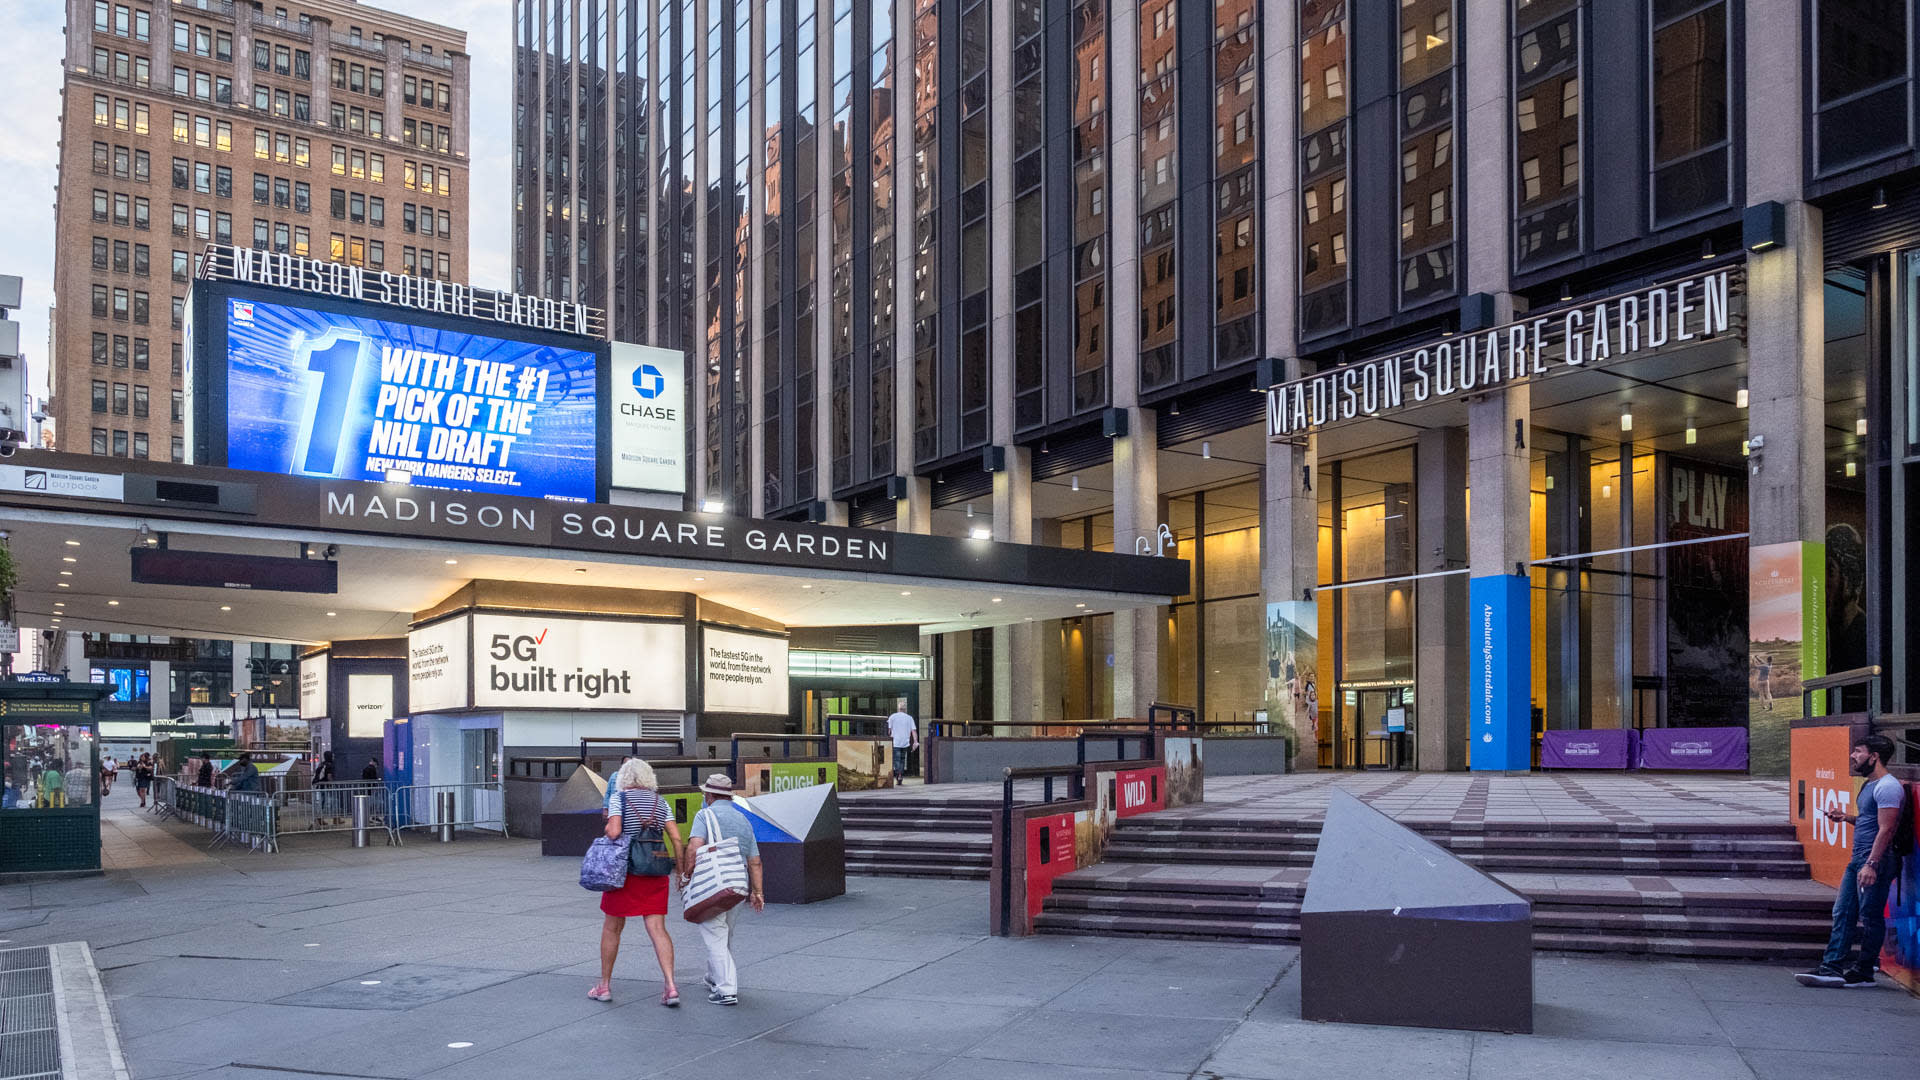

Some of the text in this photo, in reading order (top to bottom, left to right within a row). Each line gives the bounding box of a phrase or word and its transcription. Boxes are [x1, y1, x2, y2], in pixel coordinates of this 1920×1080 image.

[233, 246, 587, 335] MADISON SQUARE GARDEN
[381, 346, 550, 402] WITH THE #1
[1268, 271, 1728, 436] MADISON SQUARE GARDEN
[294, 329, 370, 478] 1
[375, 384, 536, 435] PICK OF THE
[620, 402, 676, 421] CHASE
[368, 419, 516, 467] NHL DRAFT
[365, 456, 395, 473] NEW
[395, 459, 425, 477] YORK
[425, 462, 476, 482] RANGERS
[475, 467, 522, 487] SELECT...
[1672, 467, 1728, 529] PLAY
[327, 491, 886, 560] MADISON SQUARE GARDEN
[490, 634, 537, 661] 5G
[710, 648, 763, 663] The fastest 5G in the
[710, 661, 771, 674] world, from the network
[1483, 603, 1494, 725] AbsolutelyScottsdale.com
[490, 665, 631, 698] built right
[710, 672, 724, 680] more
[725, 673, 744, 683] people
[745, 674, 754, 685] rely
[774, 775, 813, 793] ROUGH
[1123, 780, 1146, 809] WILD
[1812, 787, 1850, 848] HOT
